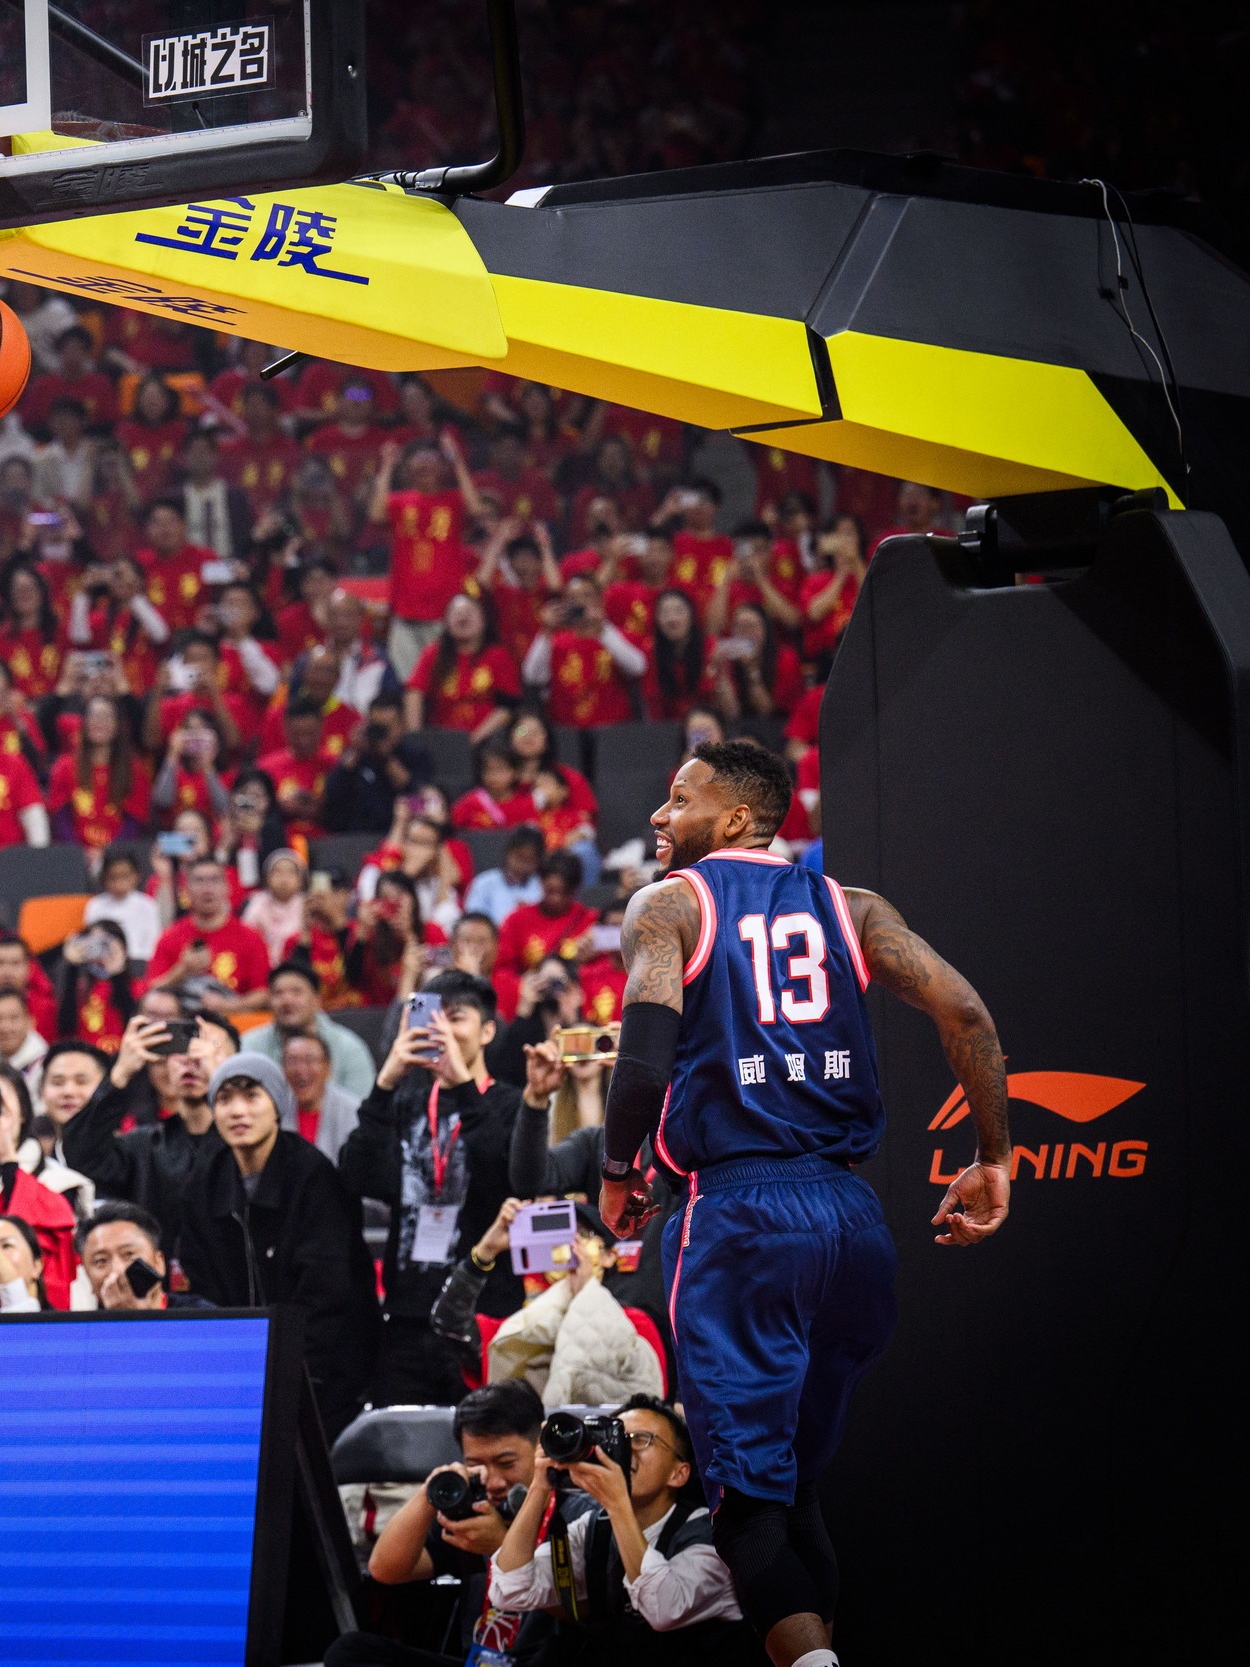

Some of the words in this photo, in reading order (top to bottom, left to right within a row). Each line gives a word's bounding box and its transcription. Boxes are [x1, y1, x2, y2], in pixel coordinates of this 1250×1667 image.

[152, 30, 265, 94] 以城之名
[135, 197, 370, 285] 金陵
[738, 911, 831, 1025] 13
[929, 1139, 1149, 1185] LNING
